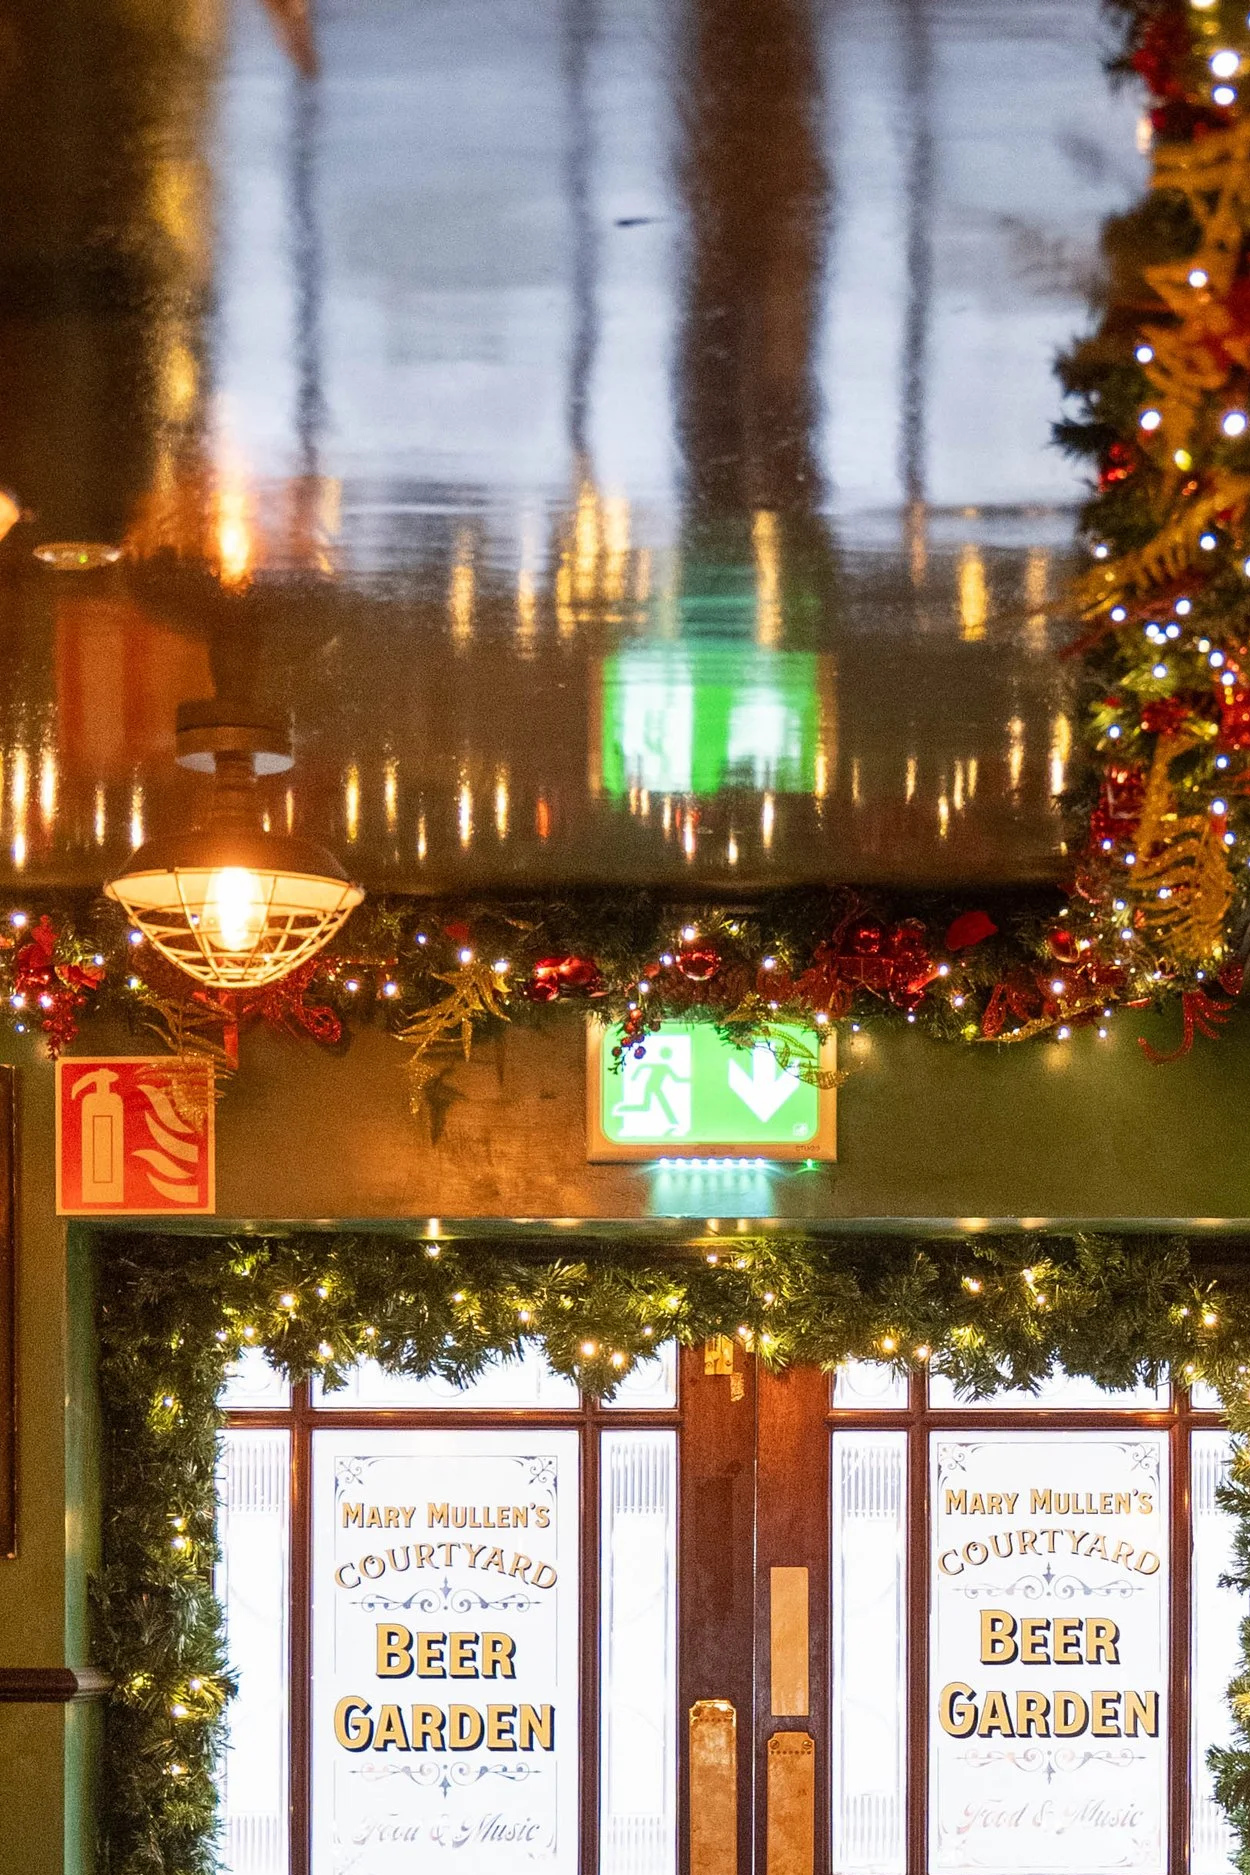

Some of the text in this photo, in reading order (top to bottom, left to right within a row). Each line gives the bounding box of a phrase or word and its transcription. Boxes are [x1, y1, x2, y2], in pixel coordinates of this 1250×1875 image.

[342, 1501, 550, 1528] MARY MULLEN'S
[945, 1488, 1153, 1514] MARY MULLEN'S
[335, 1541, 558, 1590] COURTYARD
[938, 1528, 1160, 1576] COURTYARD
[376, 1623, 516, 1679] BEER
[979, 1609, 1120, 1665] BEER
[334, 1696, 555, 1752] GARDEN
[938, 1681, 1159, 1738] GARDEN
[452, 1812, 540, 1848] Music
[956, 1798, 1029, 1835] Food
[1056, 1798, 1144, 1835] Music
